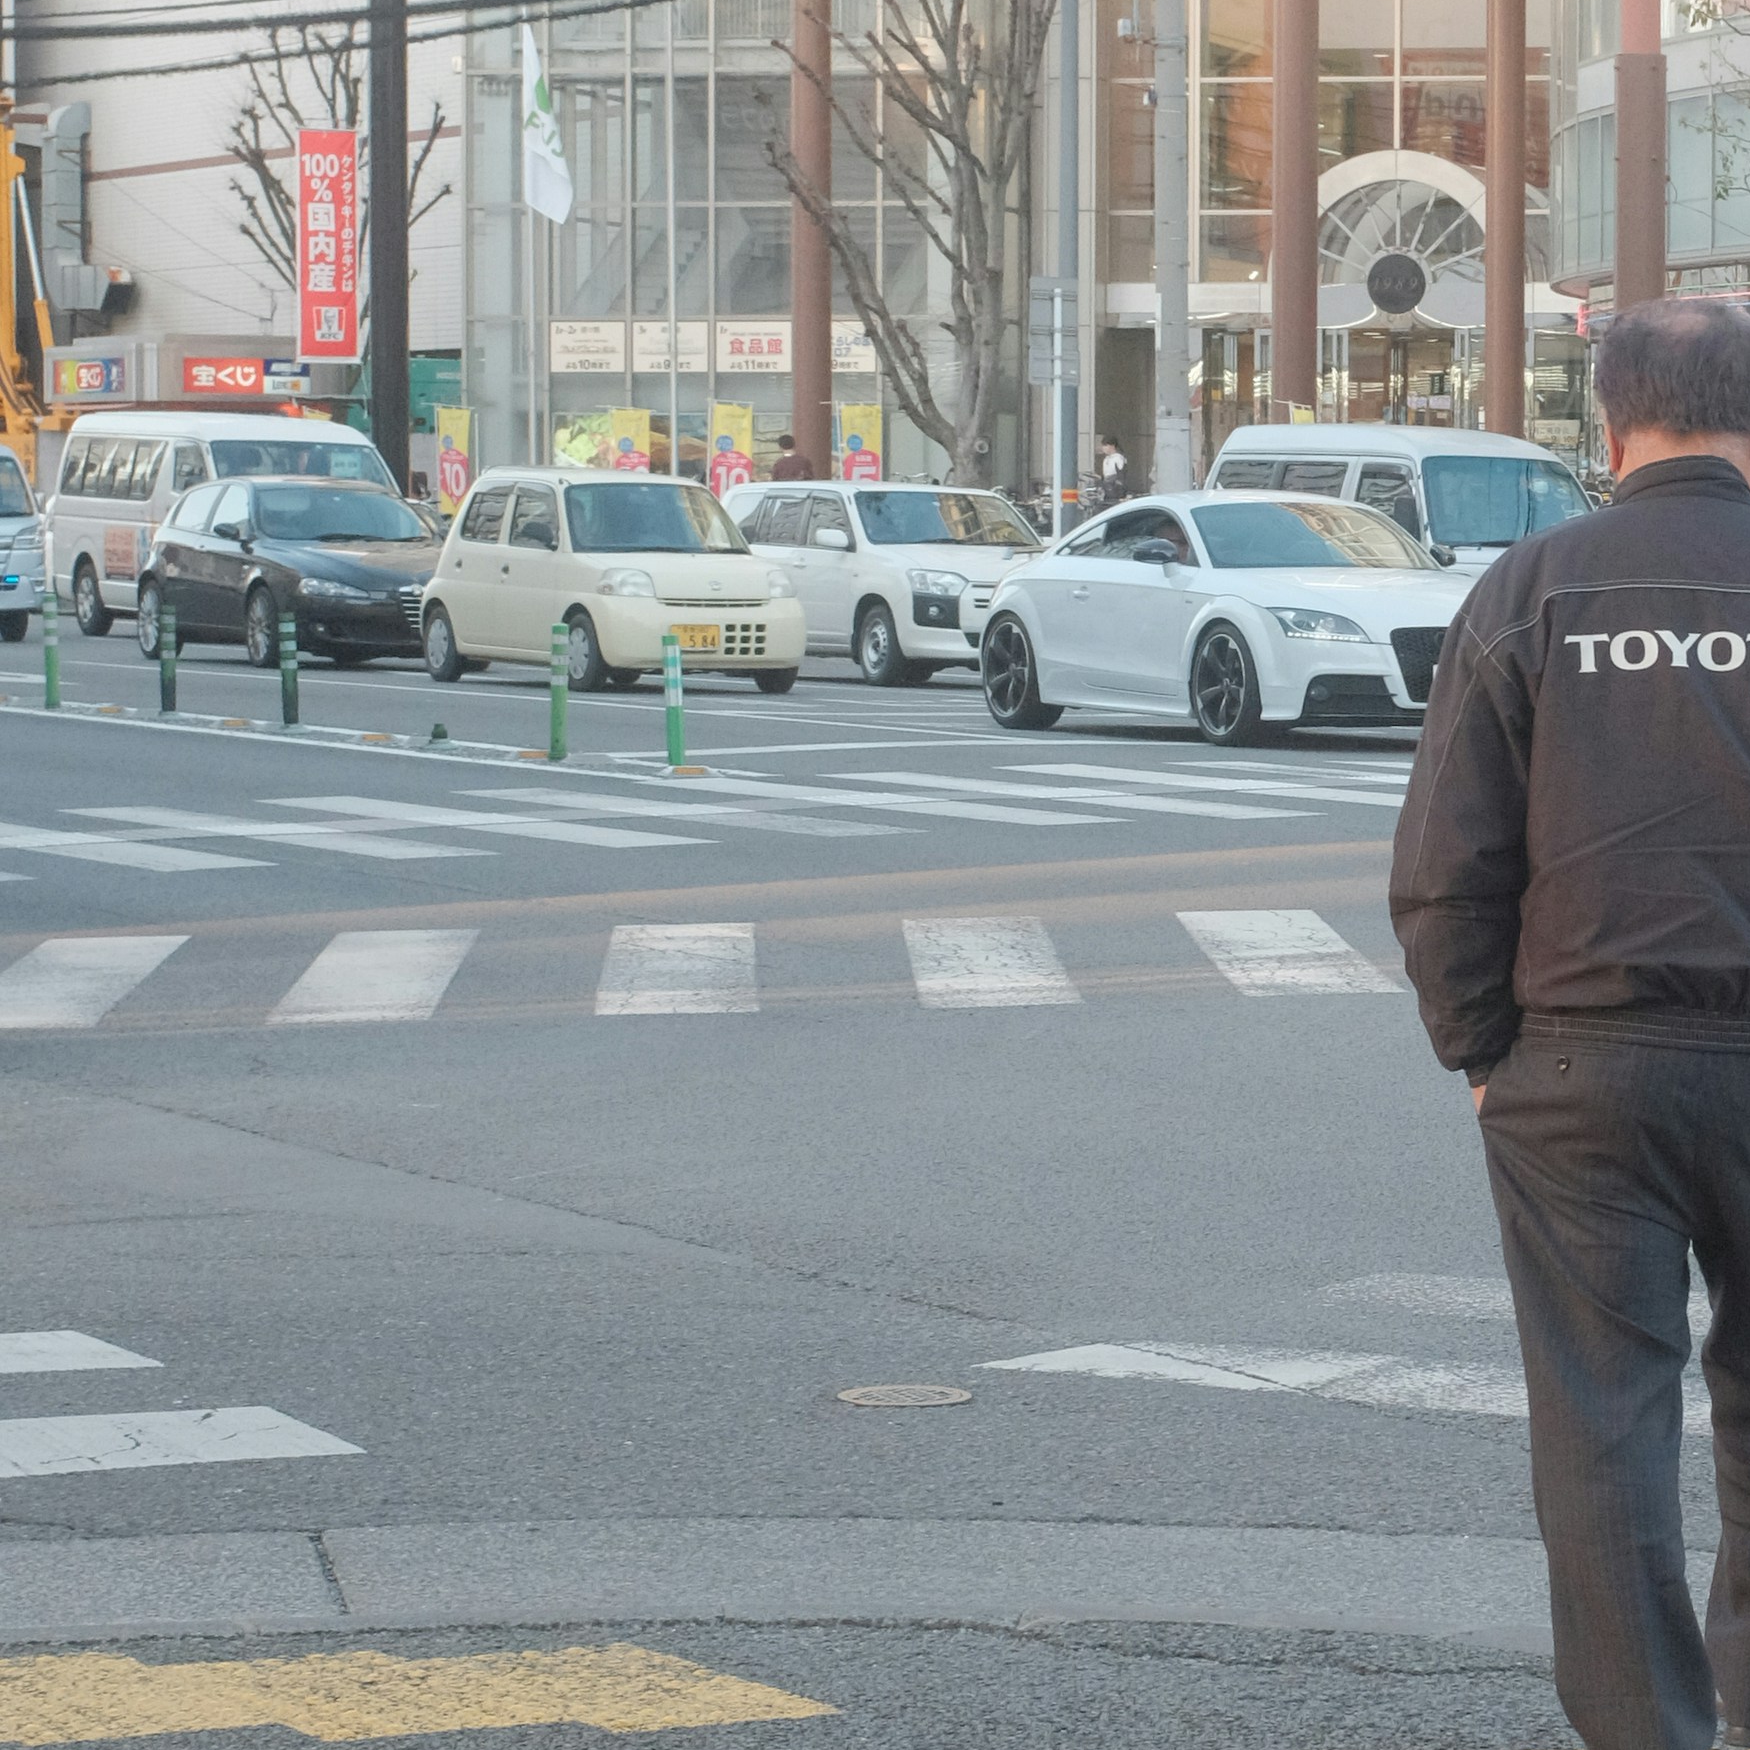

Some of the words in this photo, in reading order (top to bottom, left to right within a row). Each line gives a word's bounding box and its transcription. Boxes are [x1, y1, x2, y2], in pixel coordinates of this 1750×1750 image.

[728, 338, 783, 356] 食品館
[191, 365, 256, 387] 宝くじ
